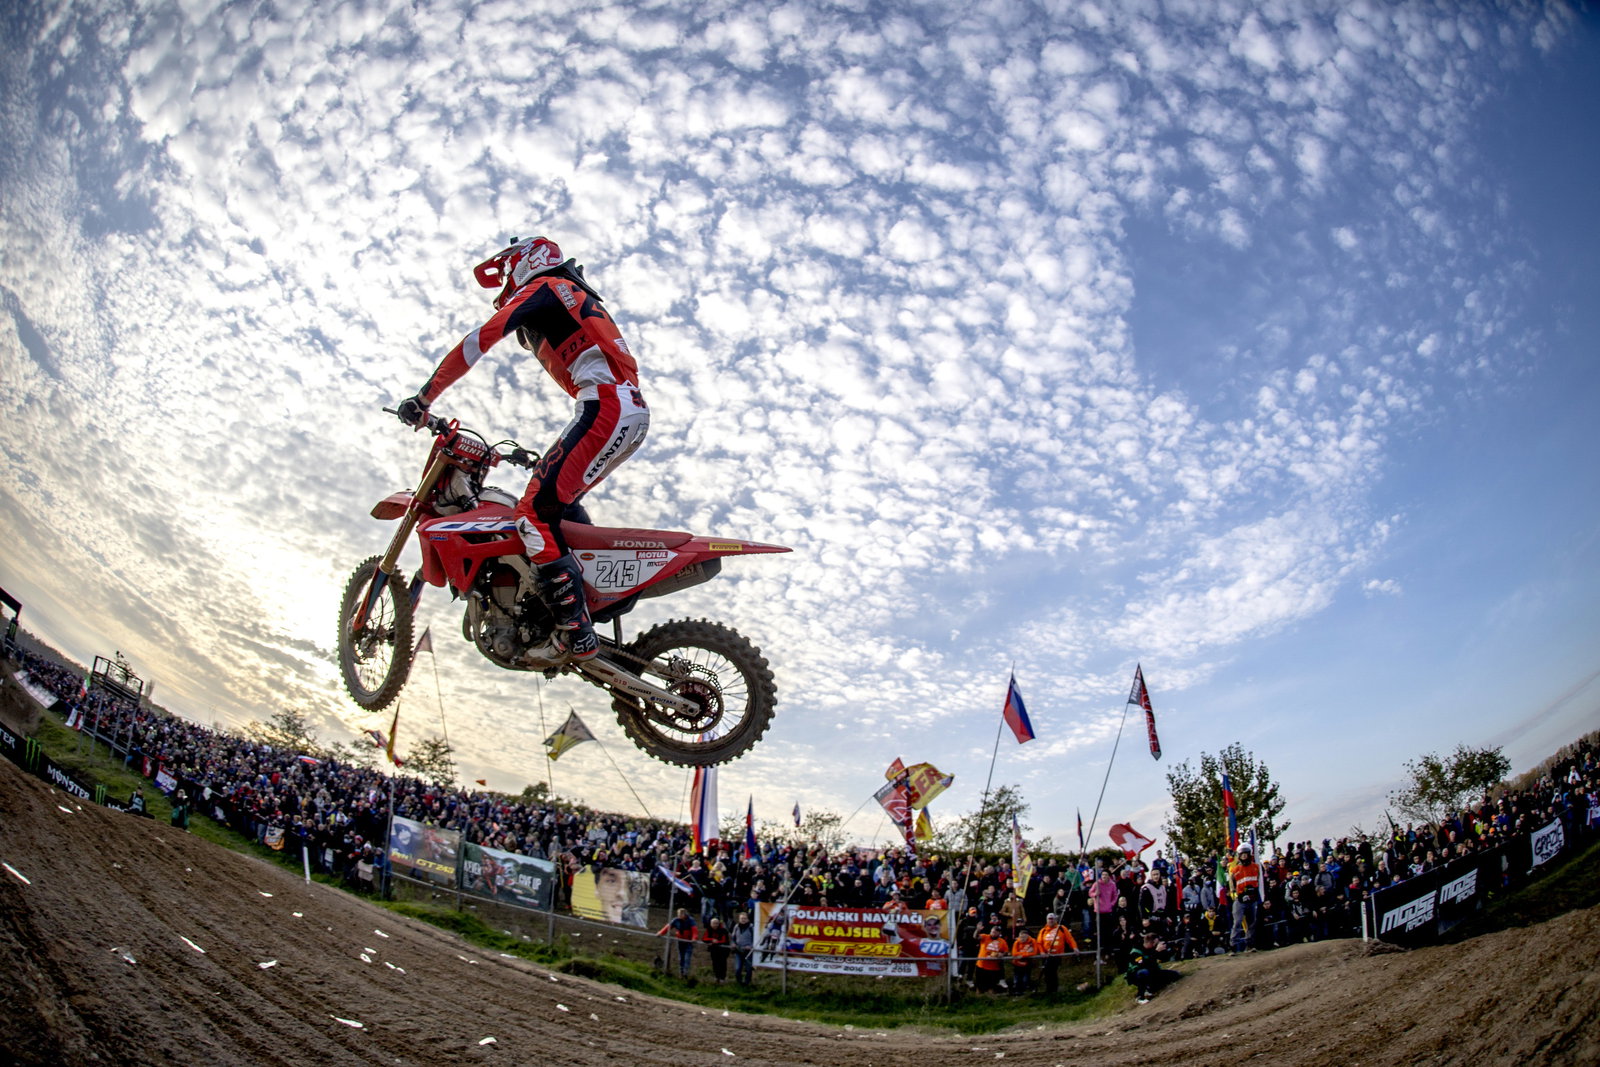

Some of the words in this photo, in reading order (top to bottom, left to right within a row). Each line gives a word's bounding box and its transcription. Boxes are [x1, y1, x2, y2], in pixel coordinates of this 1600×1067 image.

[561, 334, 587, 360] FOX
[585, 425, 630, 480] HONDA
[612, 540, 667, 549] HONDA
[637, 550, 667, 559] MOTUL
[595, 559, 642, 588] 243
[1439, 867, 1479, 905] MOOSE
[788, 909, 859, 923] POLJANSKI
[1380, 889, 1437, 935] MOOSE
[1405, 910, 1435, 933] RACING
[792, 923, 820, 936] TIM
[823, 925, 881, 939] GAJSER
